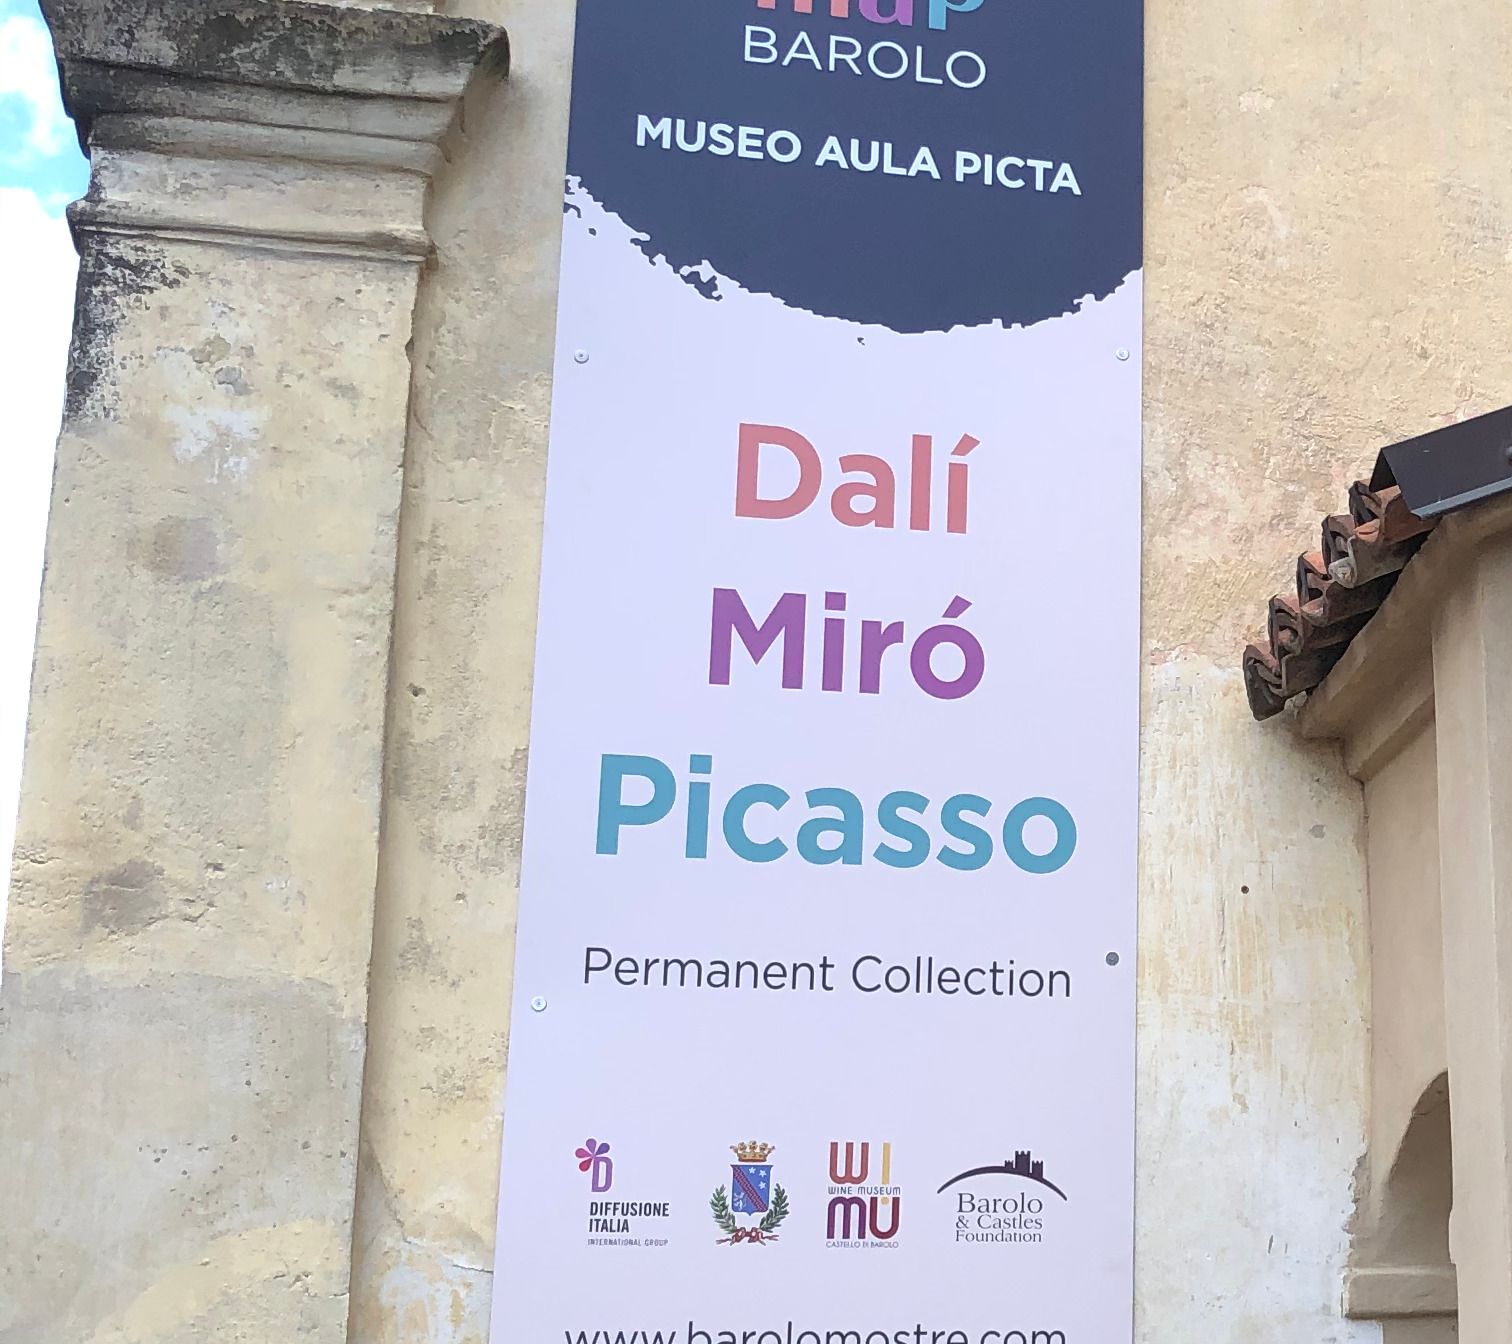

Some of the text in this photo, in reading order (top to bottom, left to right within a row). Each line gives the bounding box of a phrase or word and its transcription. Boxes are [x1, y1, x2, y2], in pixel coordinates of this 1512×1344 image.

[744, 25, 987, 89] BAROLO
[636, 114, 1083, 197] MUSEO AULA PICTA
[735, 423, 980, 534] Dalí
[709, 587, 985, 700] Miró
[596, 753, 1077, 874] Picasso
[584, 947, 1071, 997] Permanent Collection
[828, 1186, 901, 1196] WINE MUSEUM
[589, 1201, 670, 1217] DIFFUSIONE
[957, 1191, 1043, 1214] Barolo
[588, 1218, 630, 1233] ITALIA
[956, 1213, 1043, 1230] & Castles
[587, 1238, 669, 1247] INTERNATIONAL GROUP
[826, 1241, 861, 1249] CASTELLO
[870, 1241, 899, 1249] BAROLO
[955, 1229, 1042, 1244] Foundation
